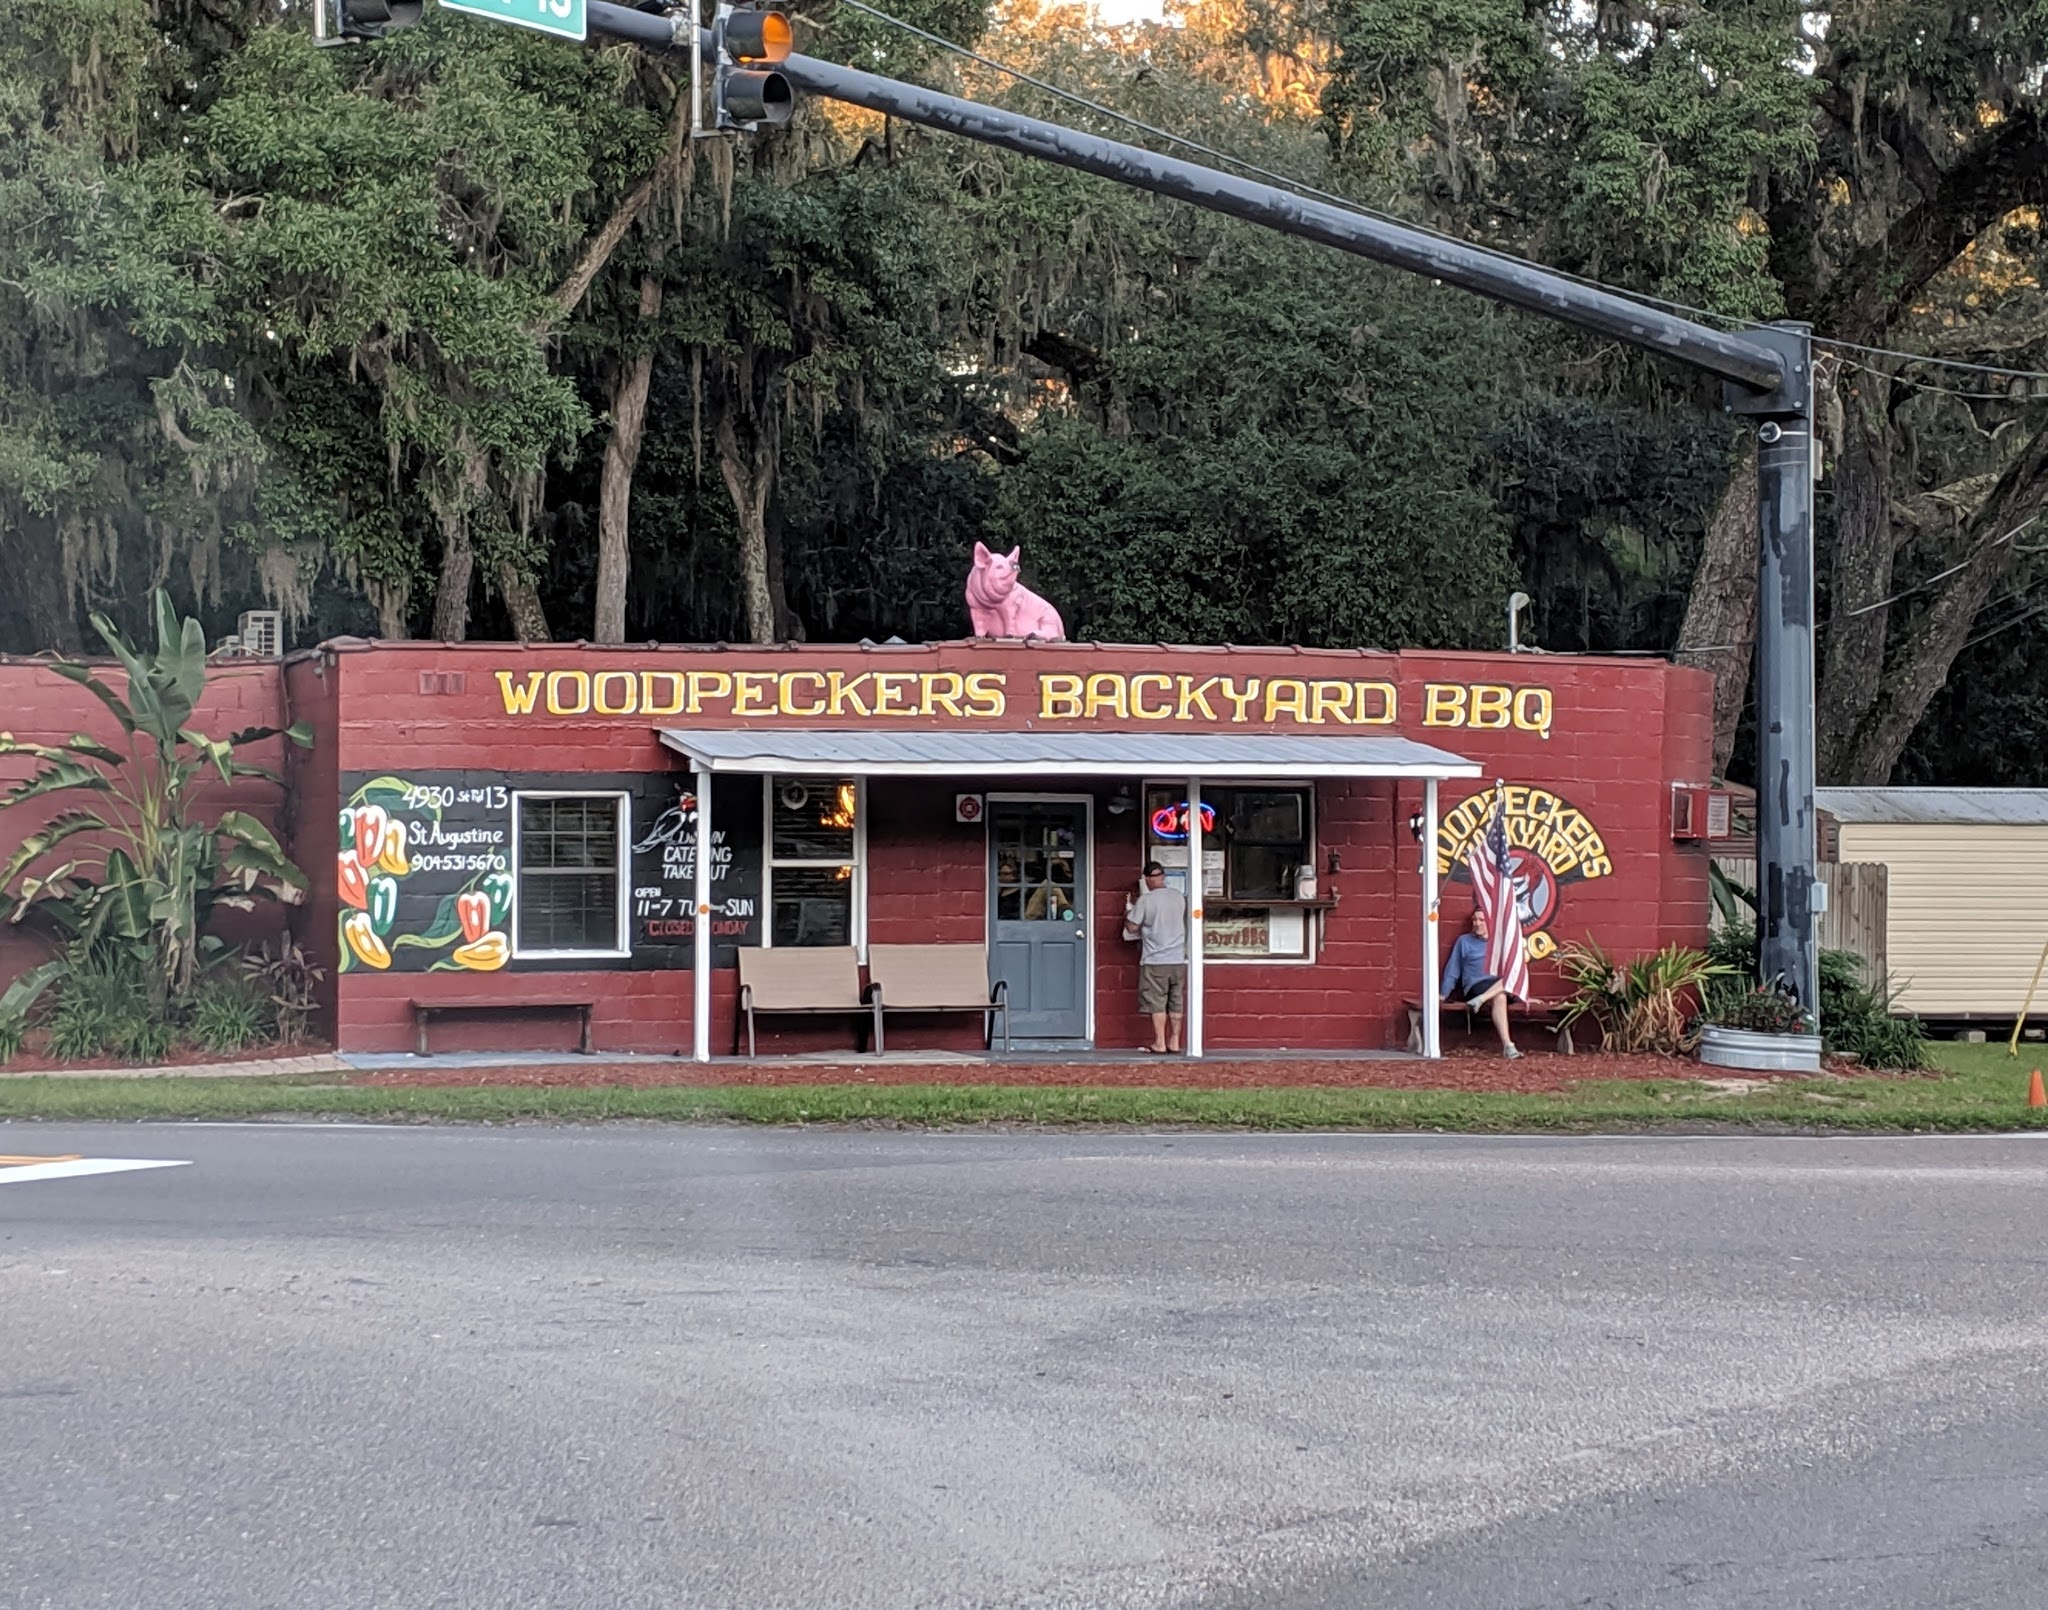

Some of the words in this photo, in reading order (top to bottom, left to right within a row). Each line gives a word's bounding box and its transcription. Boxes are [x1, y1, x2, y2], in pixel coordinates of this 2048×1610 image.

[495, 670, 1006, 717] WOODPECKERS
[1038, 673, 1397, 724] BACKYARD
[1422, 683, 1553, 739] BBQ
[402, 786, 454, 809] 4930
[485, 786, 508, 809] 13
[1152, 808, 1214, 832] ON
[408, 820, 428, 845] St
[429, 820, 504, 850] Augustine
[663, 846, 733, 862] CATENG
[661, 864, 695, 880] TAKE
[634, 887, 662, 898] OPEN
[697, 921, 749, 935] ONDAY
